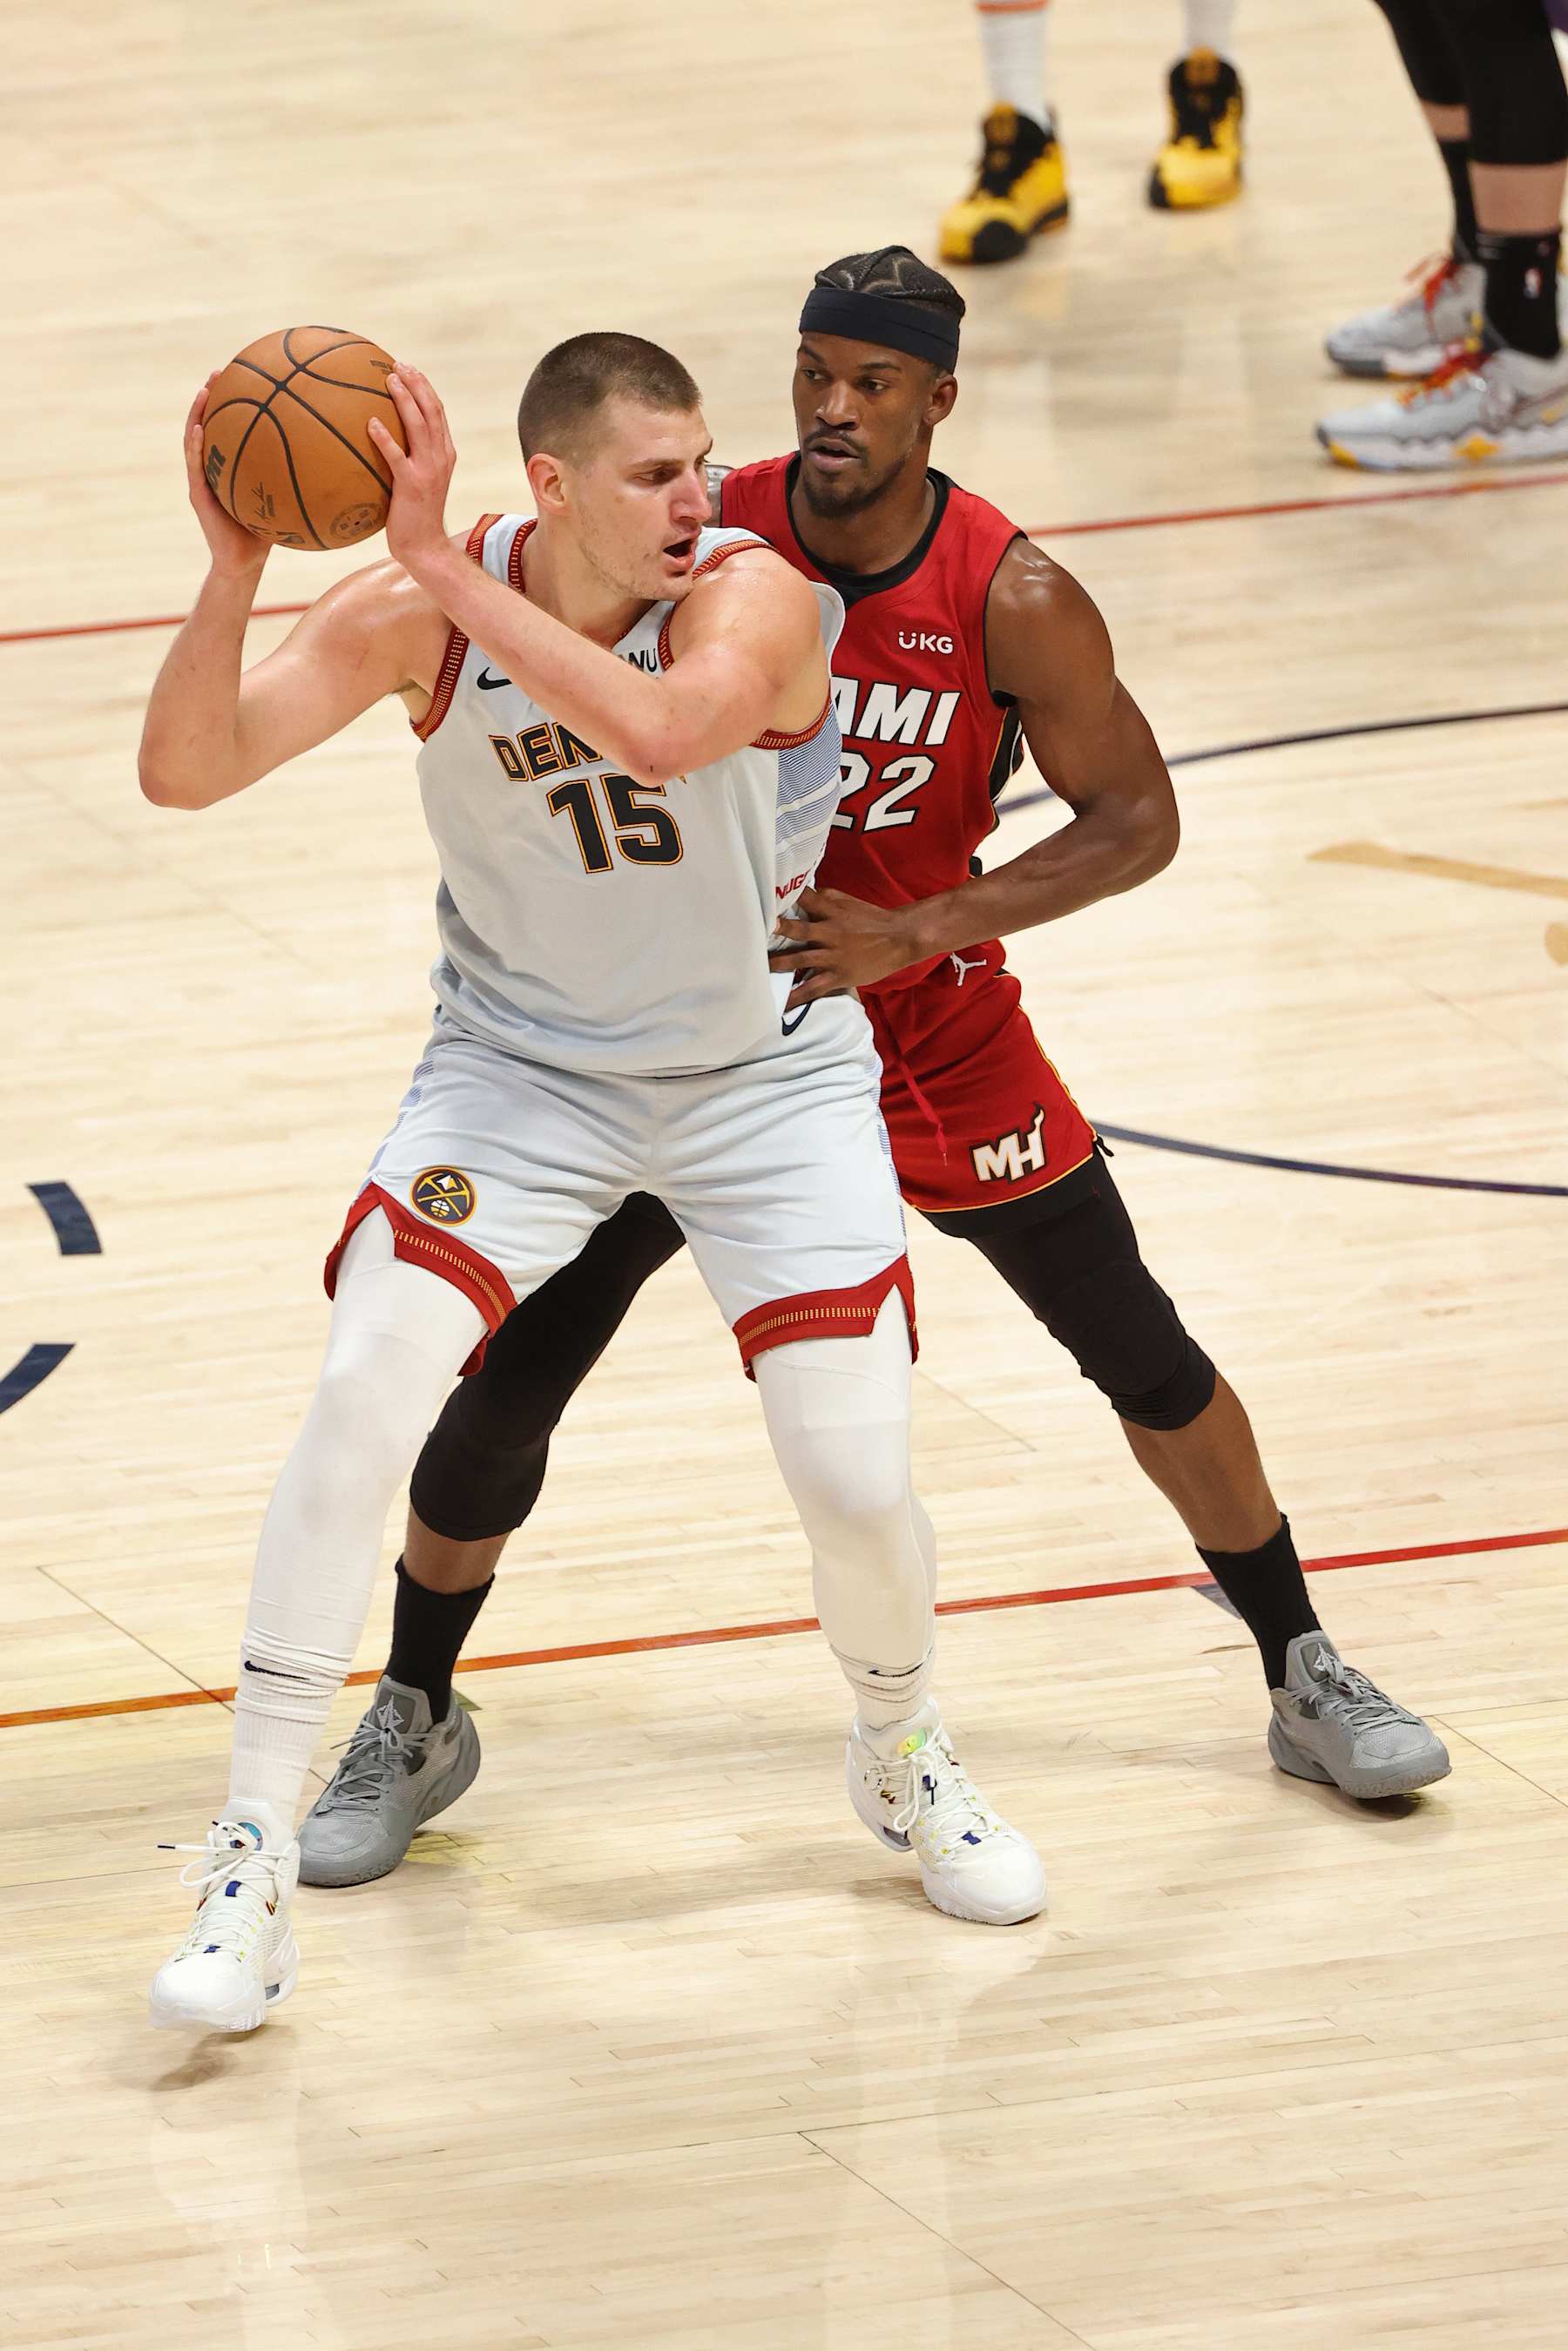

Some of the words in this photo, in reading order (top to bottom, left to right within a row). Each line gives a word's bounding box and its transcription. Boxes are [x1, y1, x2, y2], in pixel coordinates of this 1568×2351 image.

[830, 675, 961, 746] AMI
[488, 722, 604, 782] DEN
[546, 772, 684, 874] 15
[830, 752, 936, 832] 22
[775, 871, 809, 899] NUG
